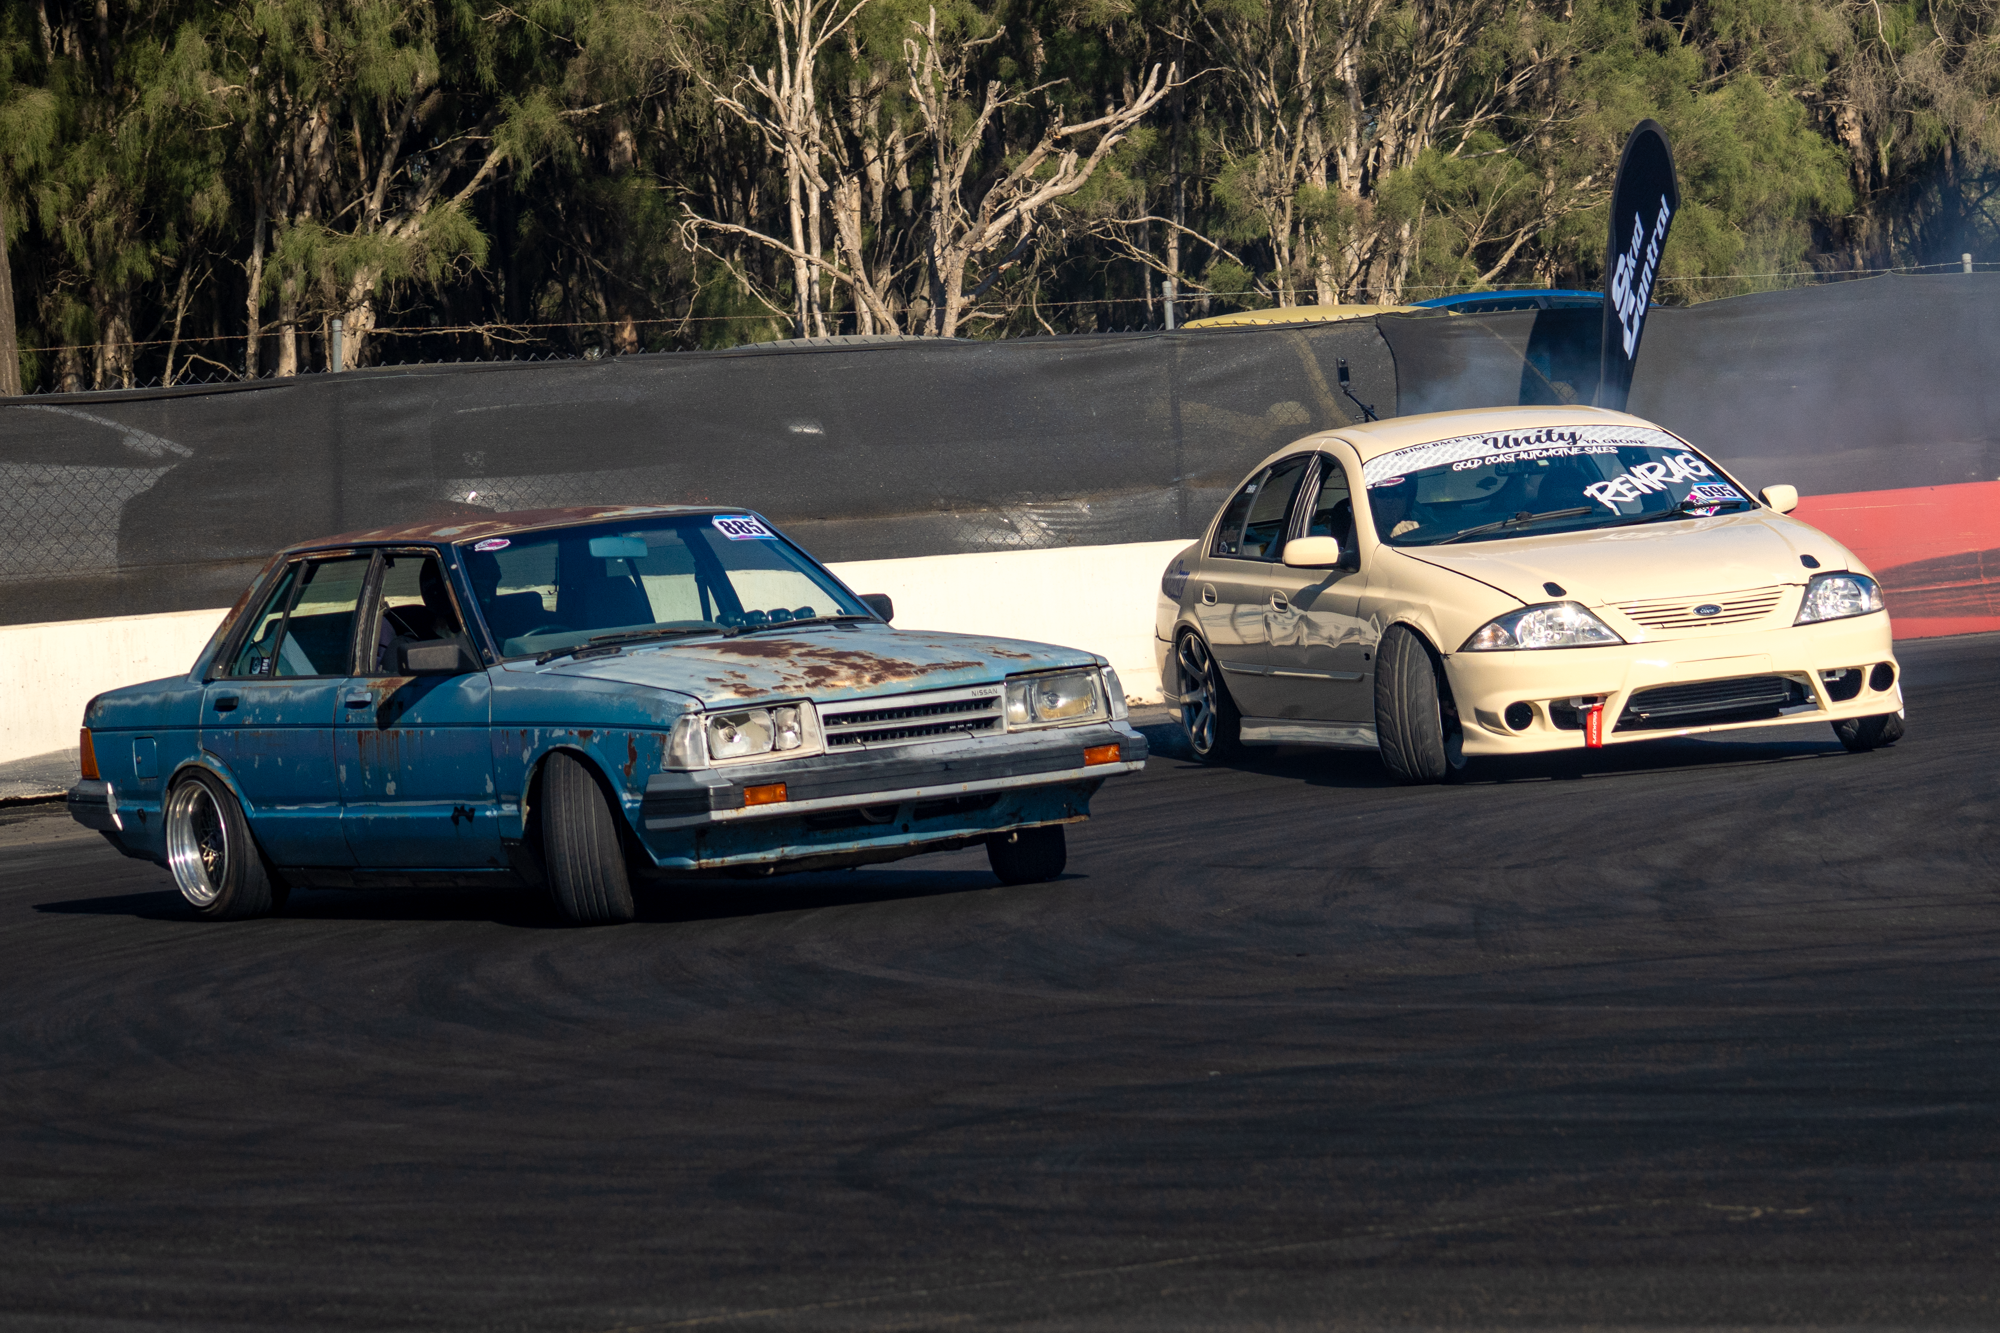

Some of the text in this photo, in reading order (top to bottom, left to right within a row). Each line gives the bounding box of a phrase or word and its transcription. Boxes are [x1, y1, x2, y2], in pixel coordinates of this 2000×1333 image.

[1612, 212, 1644, 324] Skid
[1623, 194, 1670, 360] Control
[1394, 444, 1430, 457] BRING
[1432, 438, 1463, 448] BACK
[1482, 429, 1583, 450] Unity
[1452, 458, 1483, 472] GOLD
[1583, 446, 1619, 455] SALES
[1583, 452, 1715, 516] RENRAG
[1696, 485, 1738, 498] 695
[717, 520, 767, 535] 885
[971, 687, 998, 697] NISSAN
